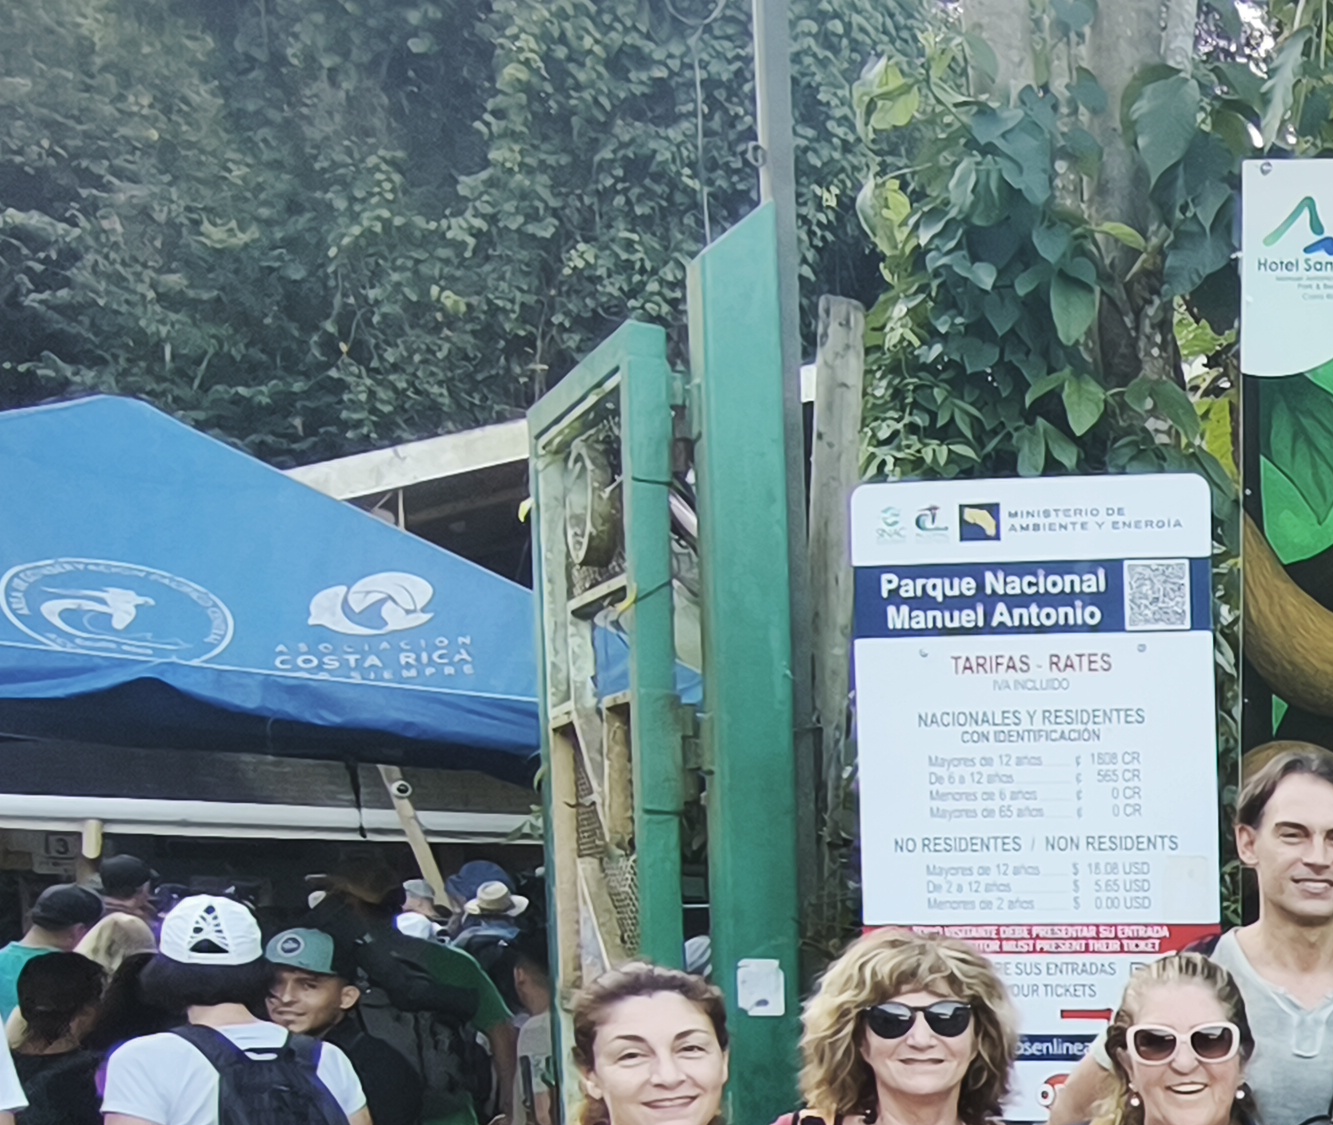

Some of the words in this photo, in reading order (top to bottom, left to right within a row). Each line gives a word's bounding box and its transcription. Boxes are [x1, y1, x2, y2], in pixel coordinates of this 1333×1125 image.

[1257, 258, 1299, 272] Hotel
[1304, 258, 1333, 272] San
[1008, 508, 1101, 519] MINISTERIO
[1105, 507, 1126, 517] DE
[1008, 521, 1090, 533] AMBIENTE
[1095, 520, 1107, 531] Y
[880, 571, 977, 603] Parque
[984, 566, 1106, 596] Nacional
[886, 605, 984, 631] Manuel
[991, 602, 1102, 628] Antonio
[274, 655, 383, 669] COSTA
[399, 648, 473, 666] RICA
[951, 654, 1030, 675] TARIFAS
[1049, 653, 1112, 673] RATES
[918, 710, 1022, 728] NACIONALES
[1026, 709, 1037, 726] Y
[1042, 708, 1146, 727] RESIDENTES
[961, 730, 990, 743] CON
[998, 754, 1012, 767] 12
[1121, 751, 1141, 766] CR
[928, 772, 945, 785] De
[970, 772, 984, 785] 12
[1097, 770, 1119, 783] 565
[1121, 769, 1142, 783] CR
[1111, 787, 1119, 800] 0
[1122, 786, 1142, 800] CR
[1112, 804, 1120, 817] 0
[1123, 803, 1143, 817] CR
[894, 837, 917, 853] NO
[922, 836, 1022, 853] RESIDENTES
[1045, 836, 1080, 852] NON
[1086, 835, 1179, 852] RESIDENTS
[996, 863, 1009, 876] 12
[1123, 862, 1150, 875] USD
[926, 881, 943, 893] De
[968, 881, 981, 893] 12
[1123, 879, 1151, 892] USD
[1123, 896, 1151, 909] USD
[1117, 925, 1170, 938] ENTRADA
[1035, 940, 1086, 952] PRESENT
[1015, 962, 1042, 976] SUS
[1046, 962, 1117, 976] ENTRADAS
[1043, 983, 1097, 998] TICKETS
